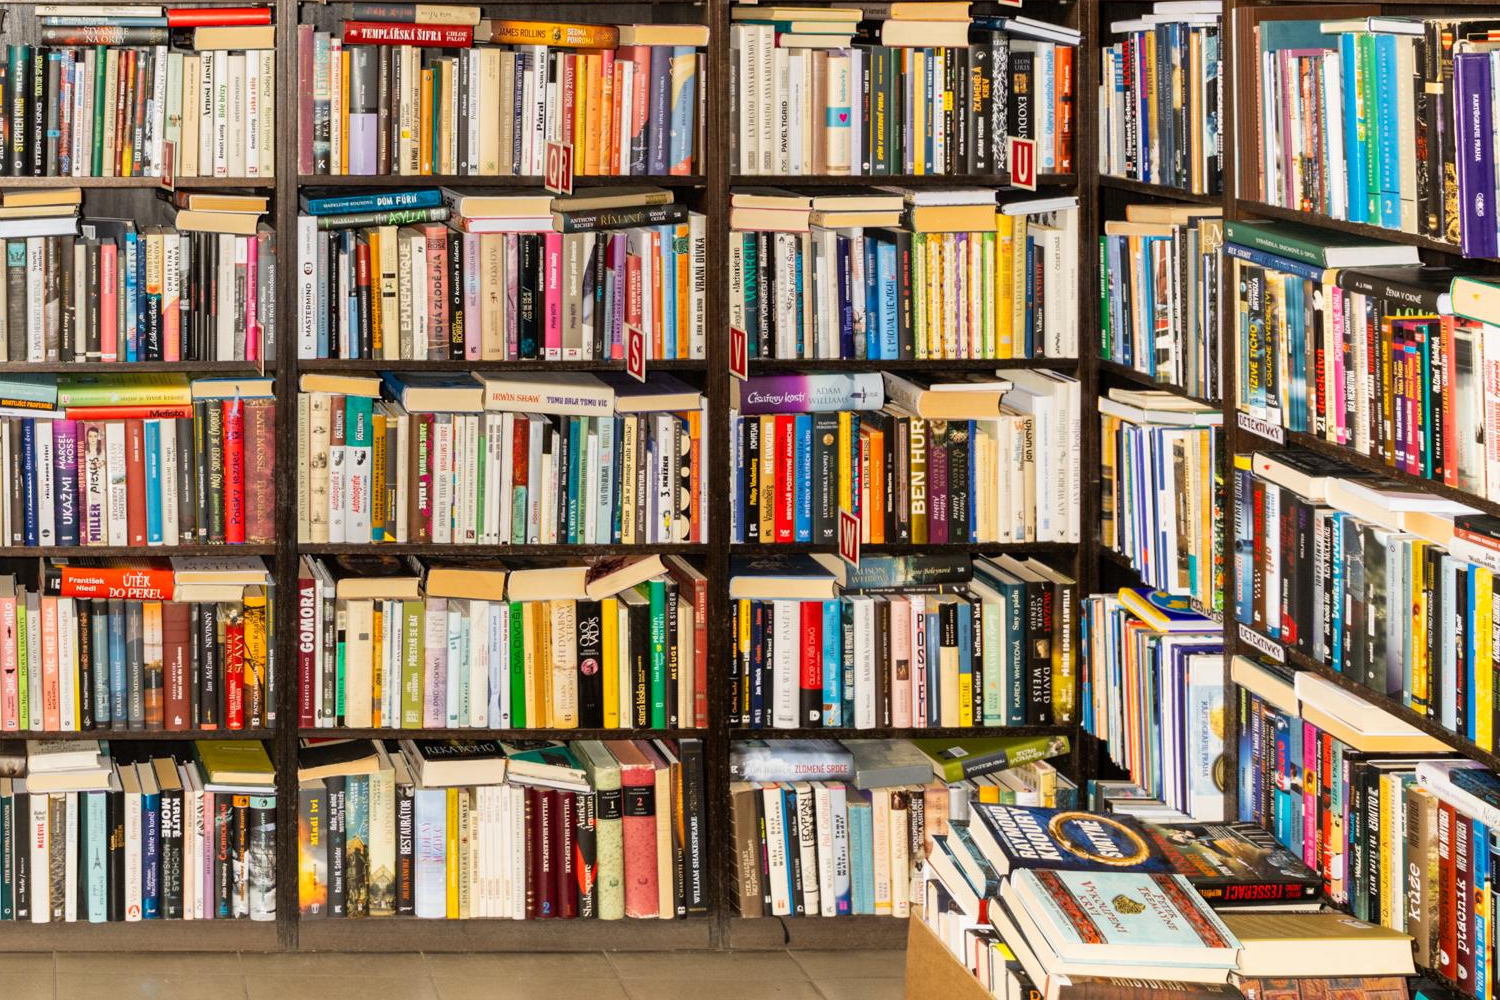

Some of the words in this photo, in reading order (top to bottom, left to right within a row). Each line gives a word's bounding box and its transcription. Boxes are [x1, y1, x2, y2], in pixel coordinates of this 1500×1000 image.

[362, 27, 415, 40] TEMPLÁŘSKÁ
[418, 29, 442, 40] ŠIFRA
[1019, 96, 1027, 142] EXODUS
[549, 148, 558, 190] Q
[1018, 144, 1029, 182] U
[377, 197, 393, 206] DŮM
[396, 194, 417, 205] FÚRIÍ
[631, 335, 639, 375] S
[733, 337, 743, 375] V
[912, 420, 925, 464] HUR
[1239, 415, 1280, 440] DETEKTIVKY
[912, 475, 925, 515] BEN
[843, 519, 854, 559] W
[68, 576, 104, 586] František
[109, 588, 126, 598] DO
[128, 586, 164, 599] PEKEL
[300, 587, 313, 653] GOMORA
[827, 763, 848, 774] SRDCE
[160, 798, 170, 838] MOŘE
[172, 798, 181, 838] KRUTÉ
[402, 800, 411, 855] RESTAURÁTOR
[1223, 884, 1283, 900] TESSERACT
[1409, 863, 1420, 922] kůže
[1457, 879, 1470, 953] ptáčník
